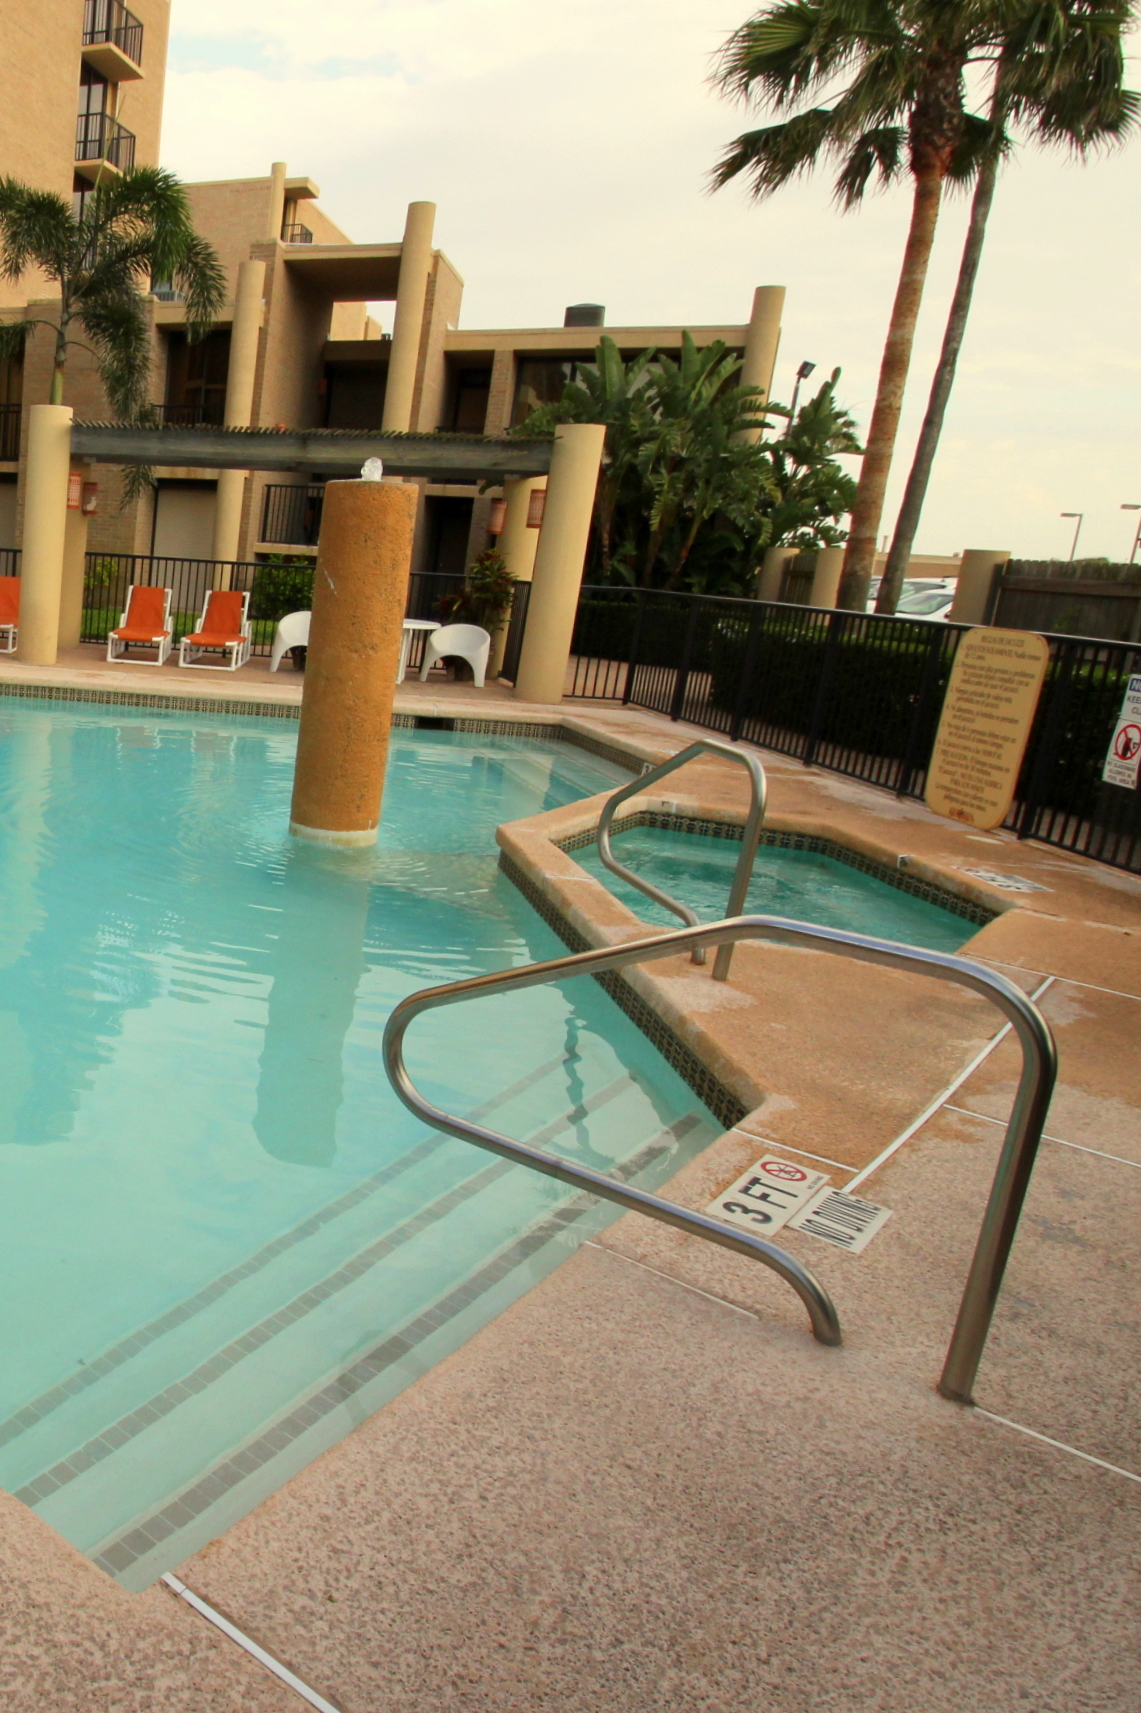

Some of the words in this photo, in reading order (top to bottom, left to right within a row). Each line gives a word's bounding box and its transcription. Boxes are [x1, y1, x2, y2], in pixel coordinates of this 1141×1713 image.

[738, 1176, 799, 1210] FT
[722, 1201, 773, 1225] 3
[812, 1190, 882, 1233] DIVING
[798, 1218, 857, 1249] NO
